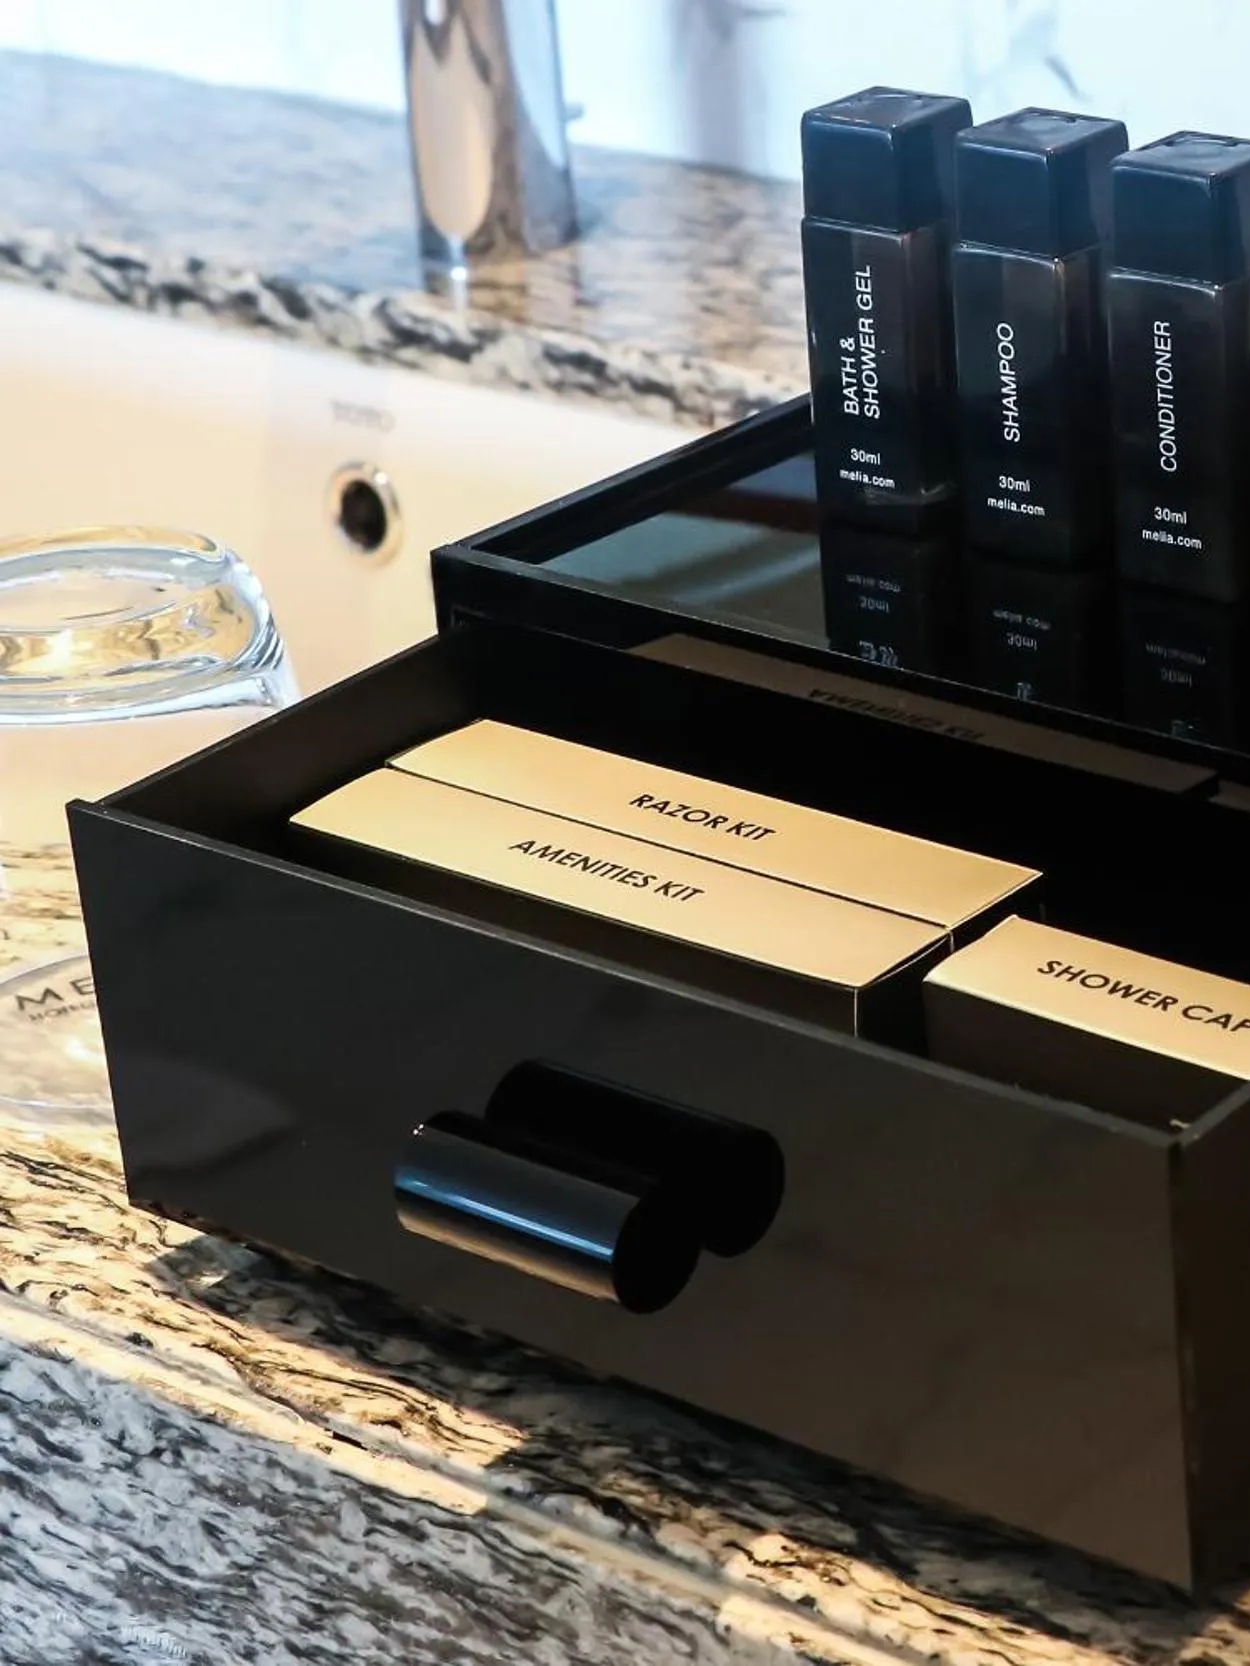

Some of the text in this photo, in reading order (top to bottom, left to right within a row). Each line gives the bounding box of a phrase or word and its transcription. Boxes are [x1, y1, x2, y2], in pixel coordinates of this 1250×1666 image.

[856, 265, 880, 420] SHOWER GEL
[840, 336, 859, 416] BATH &
[996, 322, 1020, 443] SHAMPOO
[1153, 320, 1178, 472] CONDITIONER
[840, 468, 896, 489] melia.com
[850, 447, 881, 466] 30ml
[987, 496, 1046, 517] melia.com
[998, 475, 1031, 493] 30ml
[1142, 528, 1203, 550] melia.com
[1153, 506, 1188, 525] 30ml
[629, 792, 777, 843] RAZOR KIT
[510, 838, 706, 905] AMENITIES KIT
[1036, 957, 1180, 1016] SHOWER
